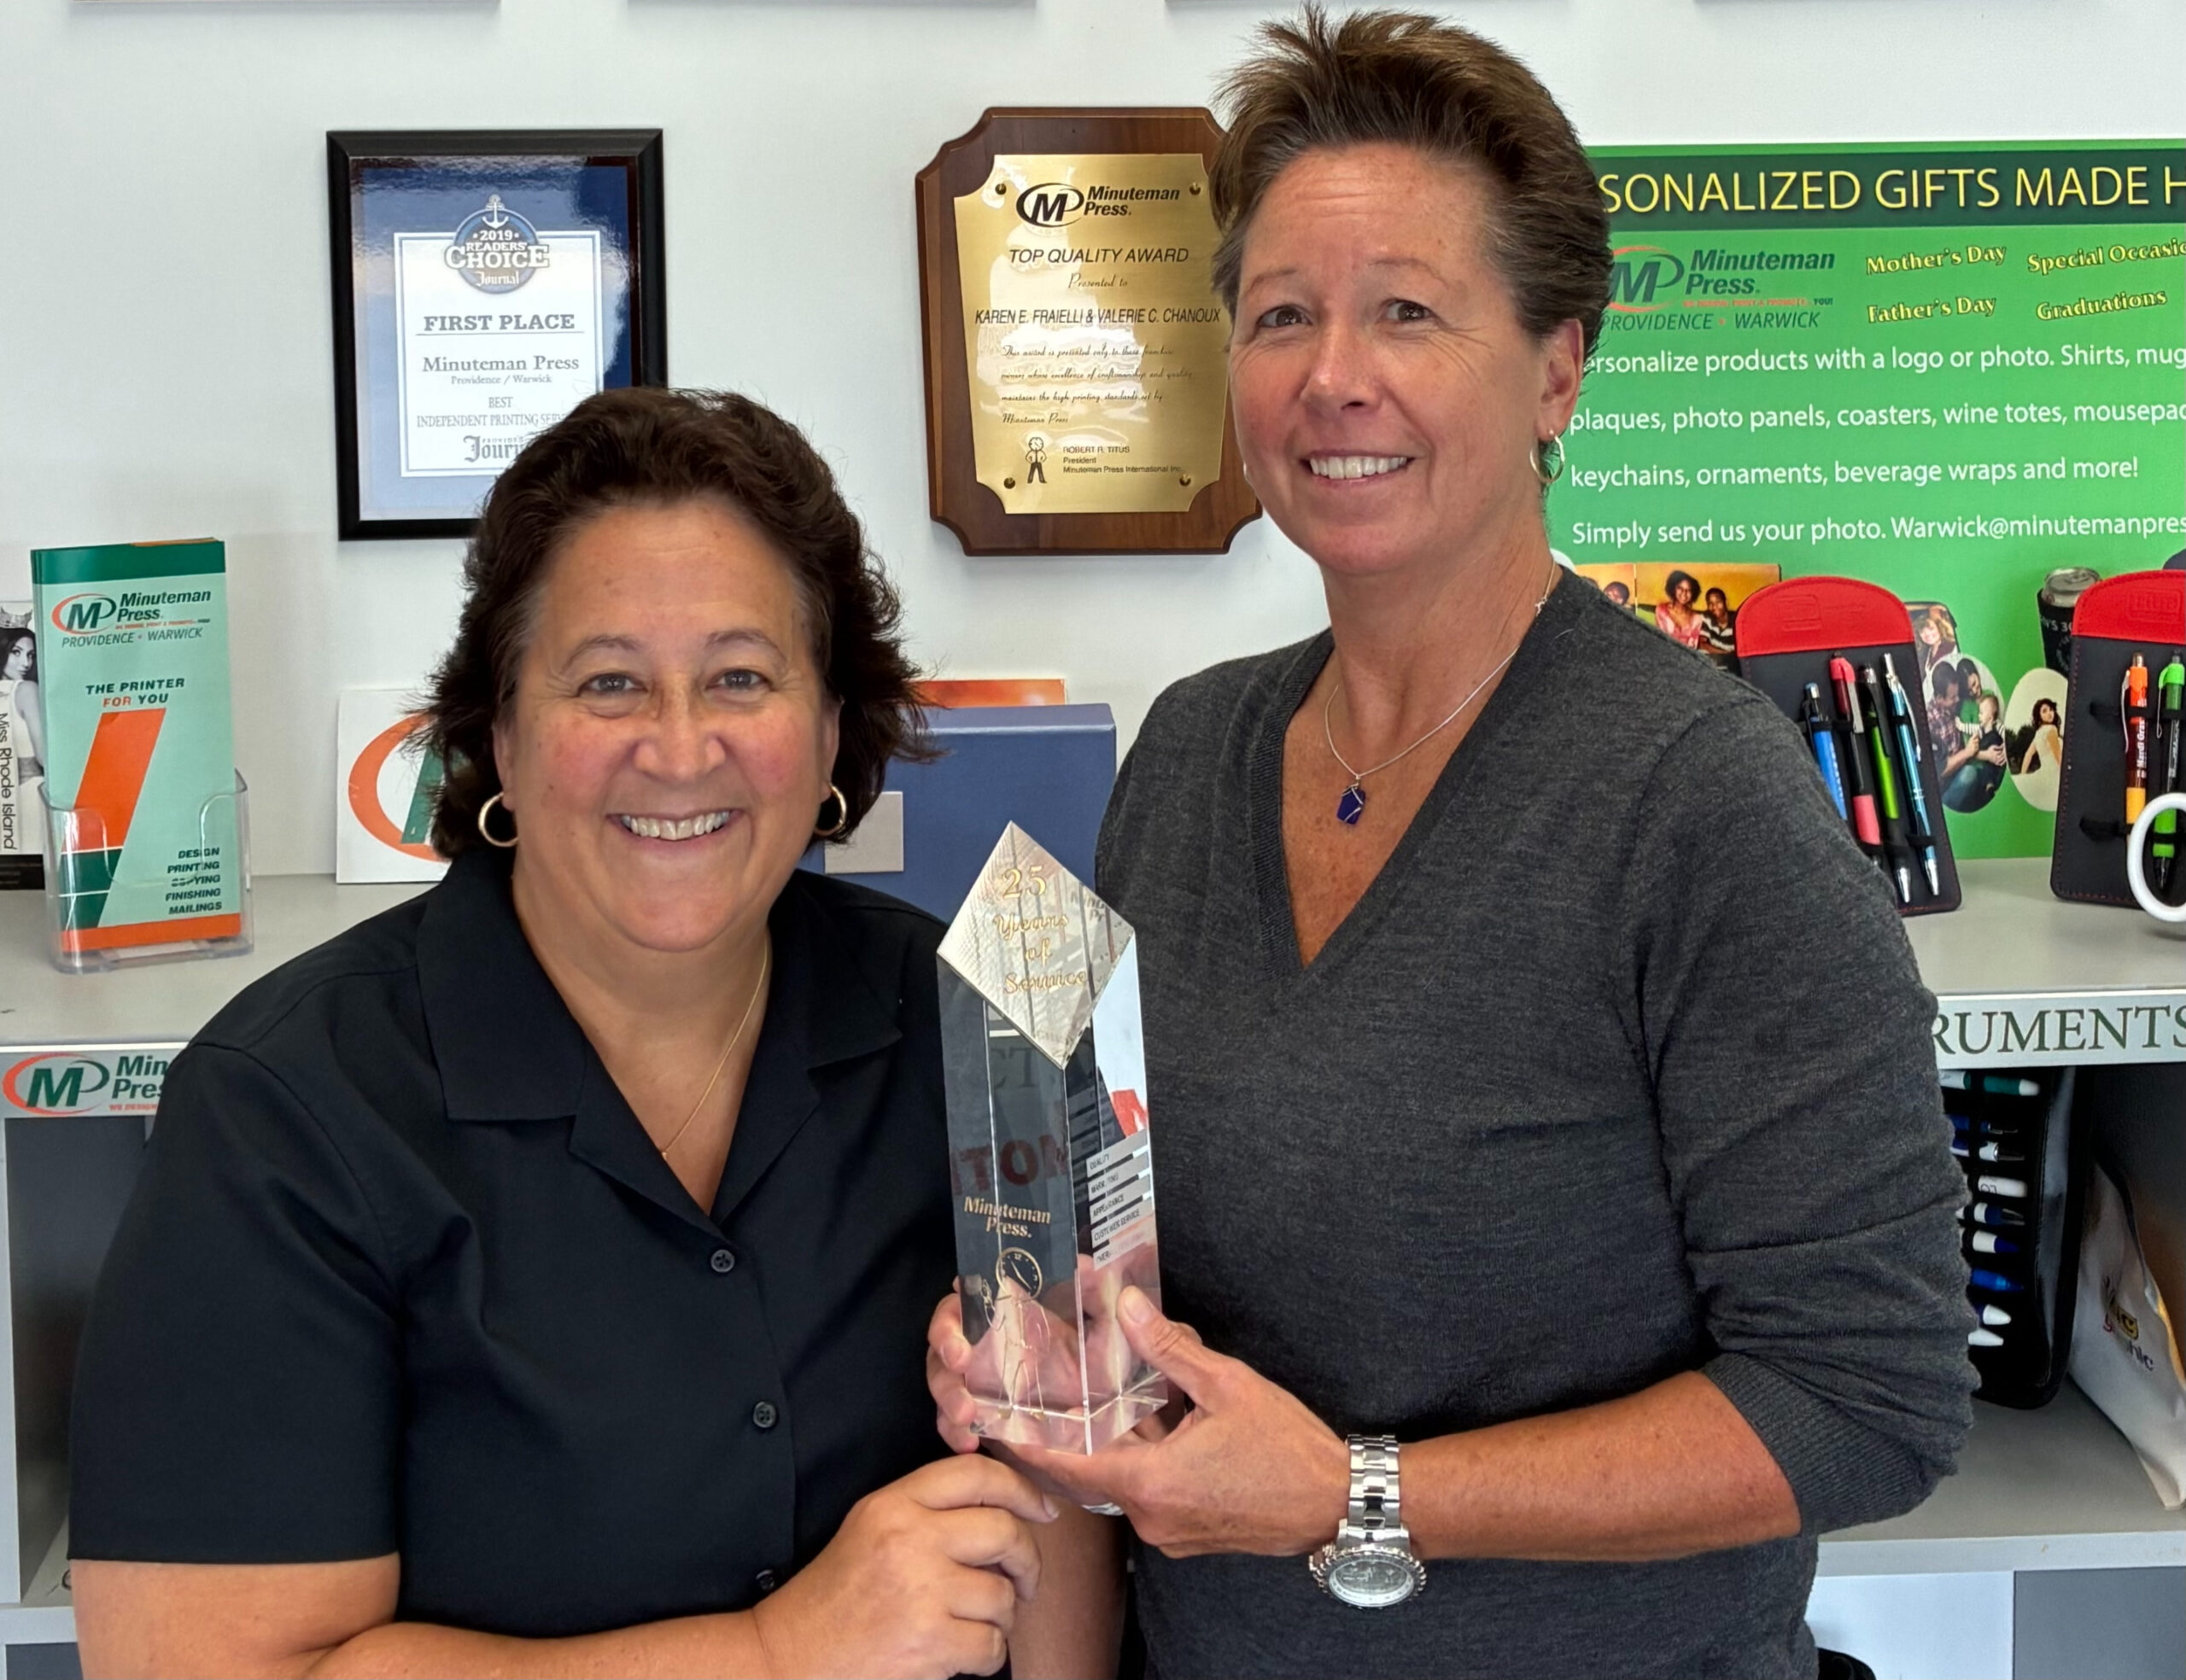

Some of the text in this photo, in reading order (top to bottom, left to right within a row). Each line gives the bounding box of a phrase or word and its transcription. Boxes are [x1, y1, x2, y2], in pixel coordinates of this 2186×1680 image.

[1087, 186, 1180, 201] Minuteman
[1598, 171, 1861, 213] SONALIZED
[1875, 168, 2000, 209] GIFTS
[2015, 166, 2149, 207] MADE
[479, 230, 512, 241] 2019
[445, 244, 549, 269] CHOICE
[1009, 248, 1189, 264] TOP QUALITY AWARD
[1690, 249, 1835, 271] Minuteman
[1866, 248, 1962, 276] Mother's
[1966, 244, 2006, 266] Day
[2027, 247, 2105, 276] Special
[475, 271, 519, 287] Journal
[1068, 272, 1128, 289] Presented to
[975, 309, 1015, 324] KAREN
[1032, 308, 1083, 324] FRAIELLI
[1086, 308, 1094, 324] &
[1098, 308, 1146, 323] VALERIE
[1149, 308, 1160, 323] C.
[1162, 307, 1220, 323] CHANOUX
[1867, 290, 2167, 324] Father's Day Graduations
[424, 314, 575, 331] FIRST PLACE
[1603, 312, 1821, 331] PROVIDENCE WARWICK
[423, 355, 580, 372] Minuteman Press
[1705, 348, 1809, 376] products
[1815, 347, 1866, 370] with
[1872, 353, 1885, 370] a
[1892, 346, 1943, 374] logo
[1949, 349, 1974, 368] or
[1980, 344, 2055, 372] photo.
[2060, 343, 2130, 368] Shirts,
[451, 375, 501, 385] Providence
[512, 374, 552, 384] Warwick
[488, 397, 513, 408] BEST
[417, 414, 488, 428] INDEPENDENT
[490, 414, 539, 427] PRINTING
[1002, 412, 1069, 424] Minuteman Press
[1570, 407, 1666, 435] plaques,
[1674, 405, 1744, 435] photo
[1750, 403, 1831, 433] panels,
[1837, 404, 1937, 429] coasters,
[1943, 403, 1998, 424] wine
[2004, 403, 2067, 426] totes,
[1125, 465, 1168, 474] International
[1571, 456, 2138, 493] keychains, ornaments, beverage wraps and more!
[1572, 519, 1651, 549] Simply
[1657, 519, 1712, 542] send
[1720, 524, 1746, 542] us
[1752, 523, 1804, 547] your
[1811, 516, 1886, 545] photo.
[120, 591, 212, 607] Minuteman
[61, 627, 203, 648] PROVIDENCE WARWICK
[85, 678, 185, 695] THE PRINTER
[102, 693, 169, 708] FOR YOU
[0, 747, 12, 799] Rhode
[2, 803, 18, 850] Island
[167, 861, 219, 873] PRINTNG
[1001, 865, 1047, 899] 25
[166, 888, 221, 901] FINISHING
[168, 901, 222, 914] MAILINGS
[992, 913, 1069, 941] Years
[1025, 937, 1053, 966] of
[1003, 969, 1088, 995] Service
[964, 1196, 1051, 1224] Minuteman
